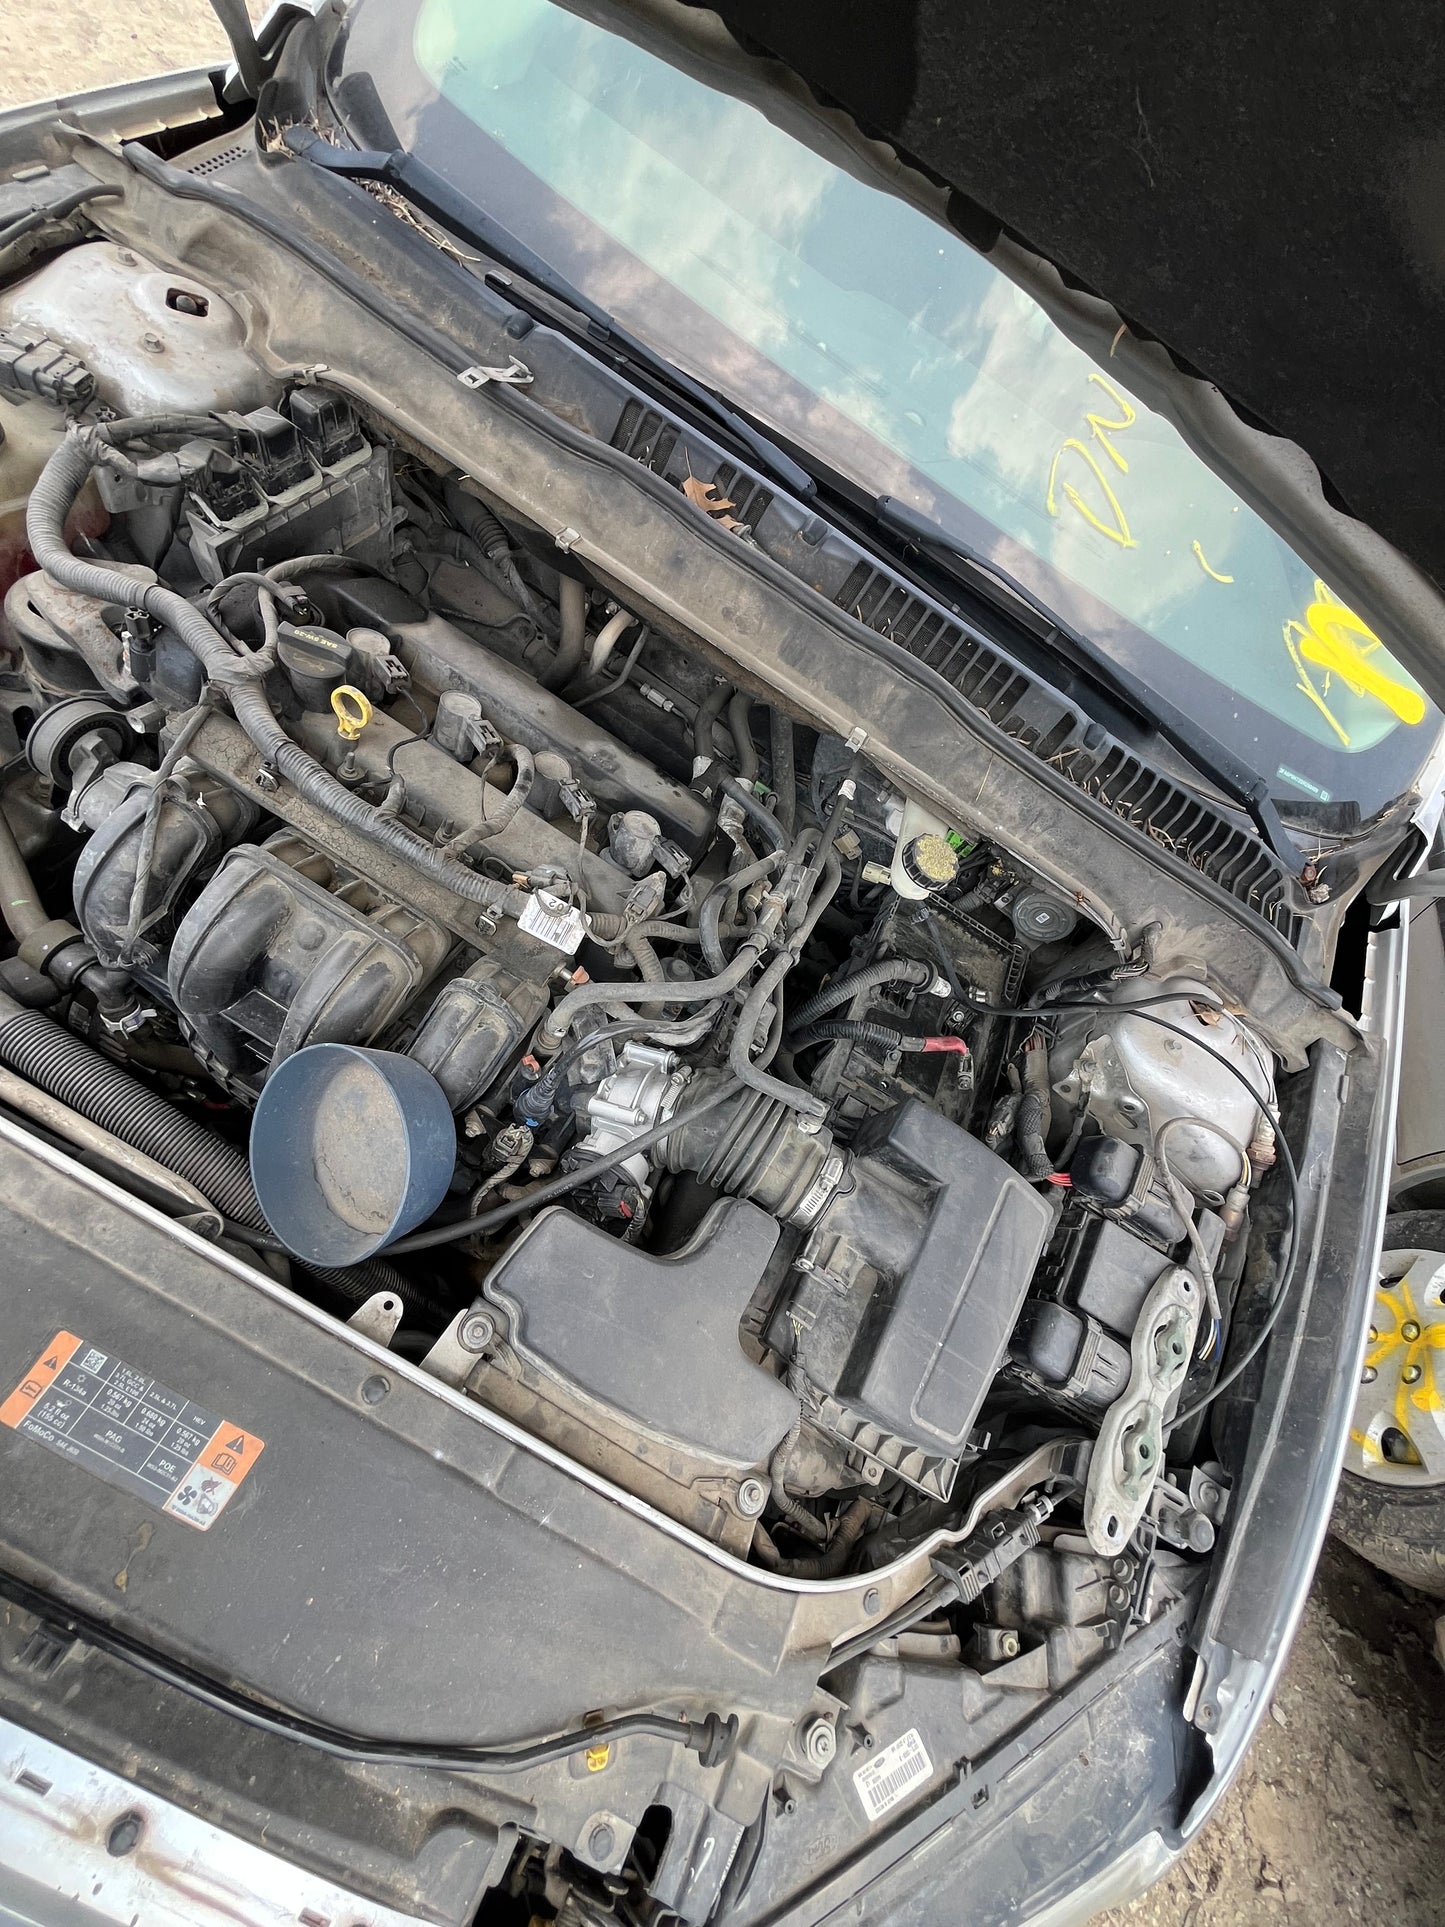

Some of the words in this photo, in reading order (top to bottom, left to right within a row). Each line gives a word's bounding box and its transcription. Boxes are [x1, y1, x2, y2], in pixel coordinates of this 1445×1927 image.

[293, 629, 320, 642] 5W-20
[319, 640, 338, 649] SAE
[62, 1378, 87, 1396] R-134a
[126, 1378, 139, 1388] GCC
[106, 1387, 124, 1402] 0.567
[121, 1397, 133, 1408] kg
[43, 1401, 55, 1413] 5.2
[59, 1411, 69, 1421] oz
[113, 1402, 122, 1410] oz
[37, 1408, 54, 1423] (155
[52, 1416, 66, 1429] cc)
[155, 1416, 166, 1427] kg
[192, 1415, 206, 1426] HEV
[22, 1419, 55, 1442] FoMoCo
[104, 1429, 122, 1444] PAG
[175, 1427, 193, 1440] 0.567
[190, 1435, 201, 1446] kg
[158, 1458, 176, 1473] POE
